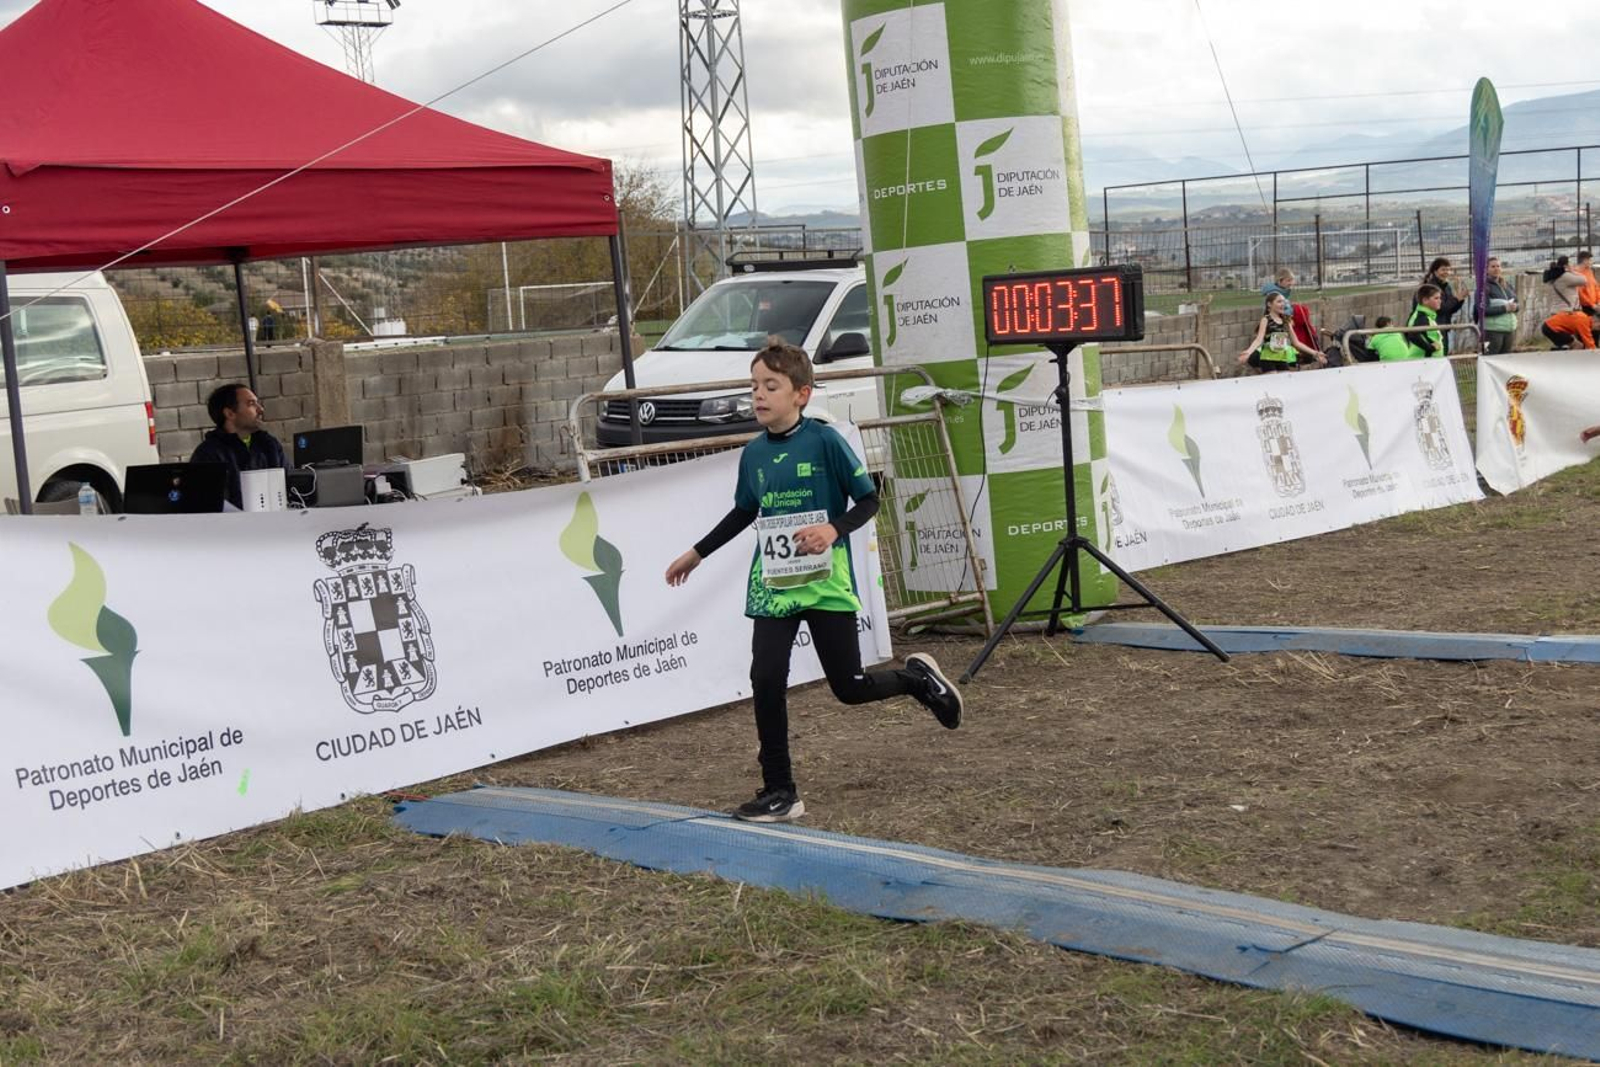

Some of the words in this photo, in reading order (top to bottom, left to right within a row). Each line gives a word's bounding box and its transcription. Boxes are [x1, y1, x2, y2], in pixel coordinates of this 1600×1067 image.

[874, 59, 938, 80] DIPUTACIÓN
[876, 83, 888, 94] DE
[889, 78, 916, 93] JAÉN
[997, 168, 1060, 184] DIPUTACIÓN
[874, 179, 947, 199] DEPORTES
[998, 186, 1014, 198] DE
[1016, 184, 1043, 197] JAÉN
[897, 296, 960, 313] DIPUTACIÓN
[992, 276, 1122, 335] 00:03:37
[898, 316, 911, 327] DE
[912, 313, 938, 326] JAÉN
[1019, 405, 1061, 418] DIPUTA
[1020, 421, 1035, 433] DE
[1269, 504, 1295, 520] CIUDAD
[1296, 502, 1306, 515] DE
[1008, 516, 1088, 536] DEPORS
[920, 543, 932, 554] DE
[933, 540, 959, 554] JAÉN
[1124, 531, 1148, 548] JAÉN
[795, 562, 827, 573] SERRANO
[542, 650, 613, 678] Patronato
[615, 635, 678, 662] Municipal
[680, 631, 698, 645] de
[566, 668, 631, 695] Deportes
[633, 663, 651, 680] de
[654, 654, 688, 676] Jaén
[315, 726, 396, 762] CIUDAD
[401, 720, 428, 742] DE
[433, 706, 483, 736] JAÉN
[14, 749, 115, 789] Patronato
[119, 729, 216, 768] Municipal
[220, 727, 244, 749] de
[48, 777, 143, 812] Deportes
[146, 769, 172, 790] de
[178, 757, 223, 783] Jaén
